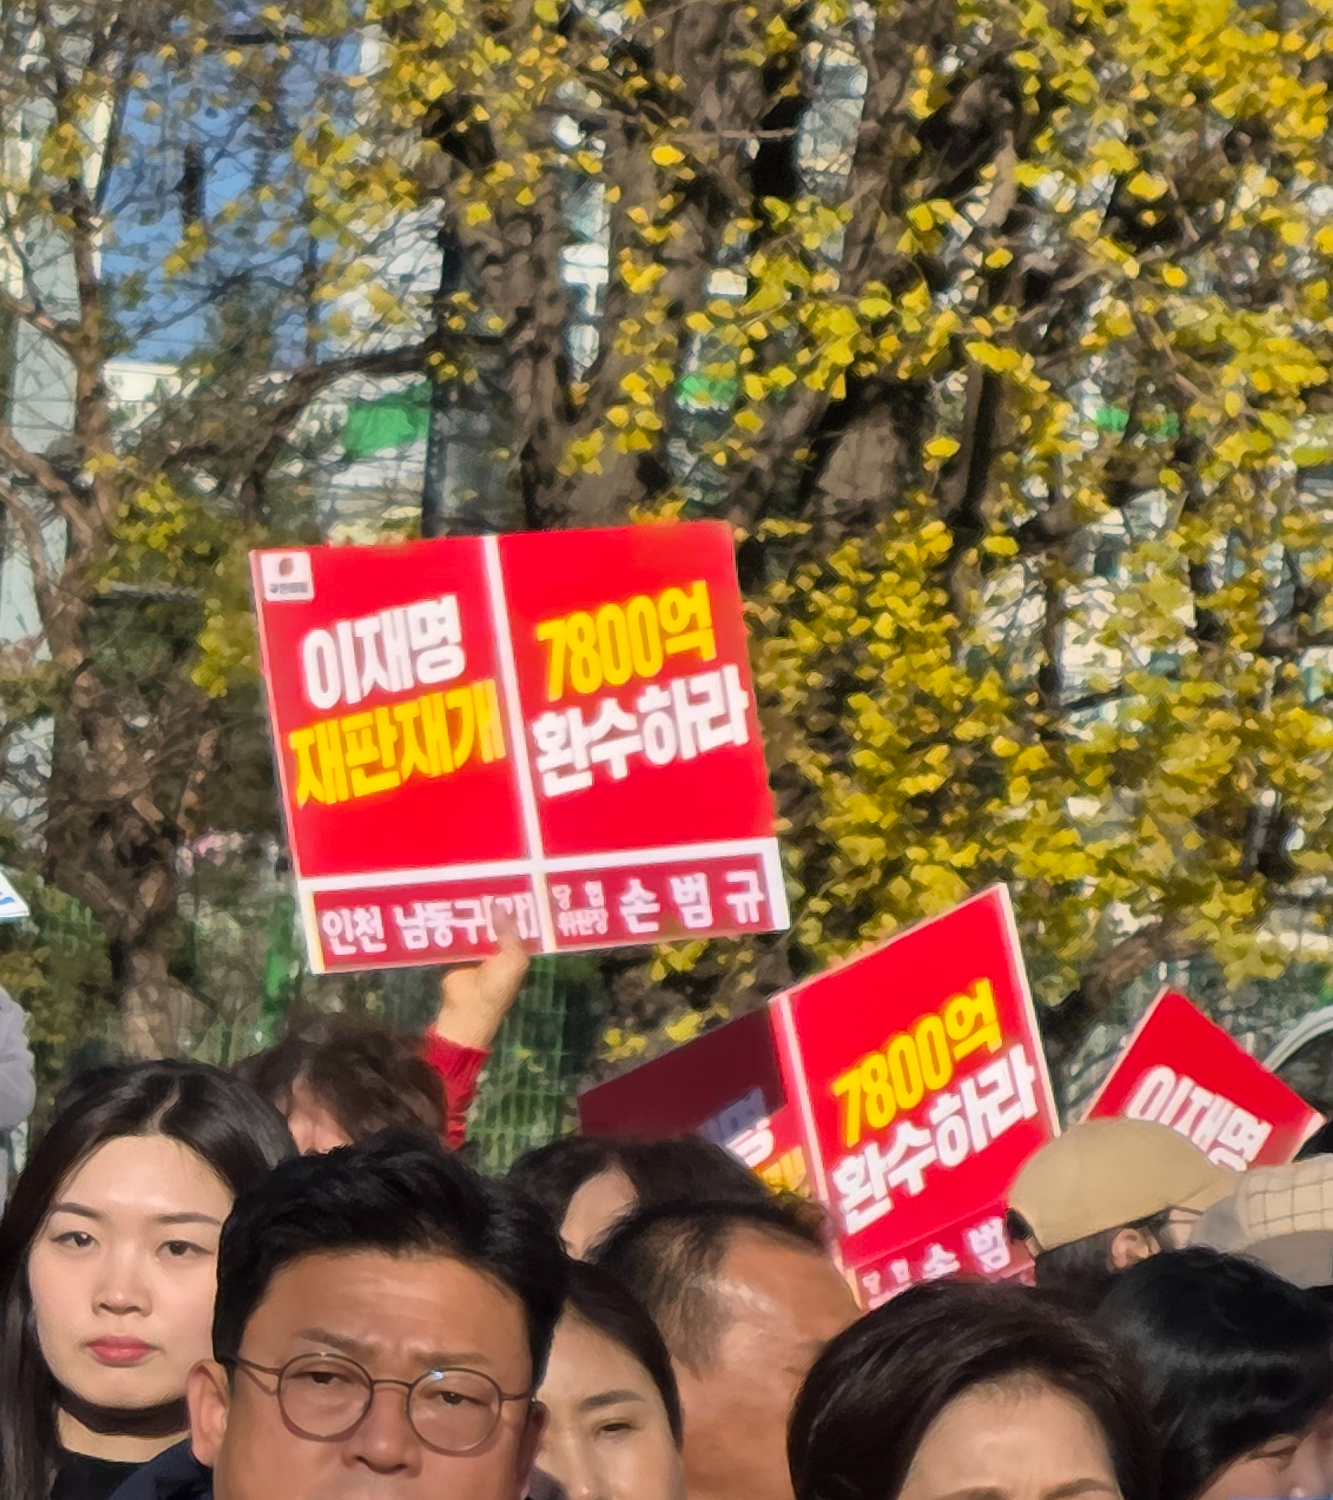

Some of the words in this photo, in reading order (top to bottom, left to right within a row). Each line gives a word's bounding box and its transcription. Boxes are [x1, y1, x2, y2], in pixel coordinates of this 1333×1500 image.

[302, 595, 467, 710] 이재명
[536, 580, 718, 702] 7800억
[288, 678, 507, 808] 재판재개
[531, 664, 750, 799] 환수하라
[322, 906, 387, 956] 인천
[832, 976, 1003, 1148] 7800억
[1126, 1065, 1272, 1173] 이재명
[833, 1043, 1039, 1236] 환수하라
